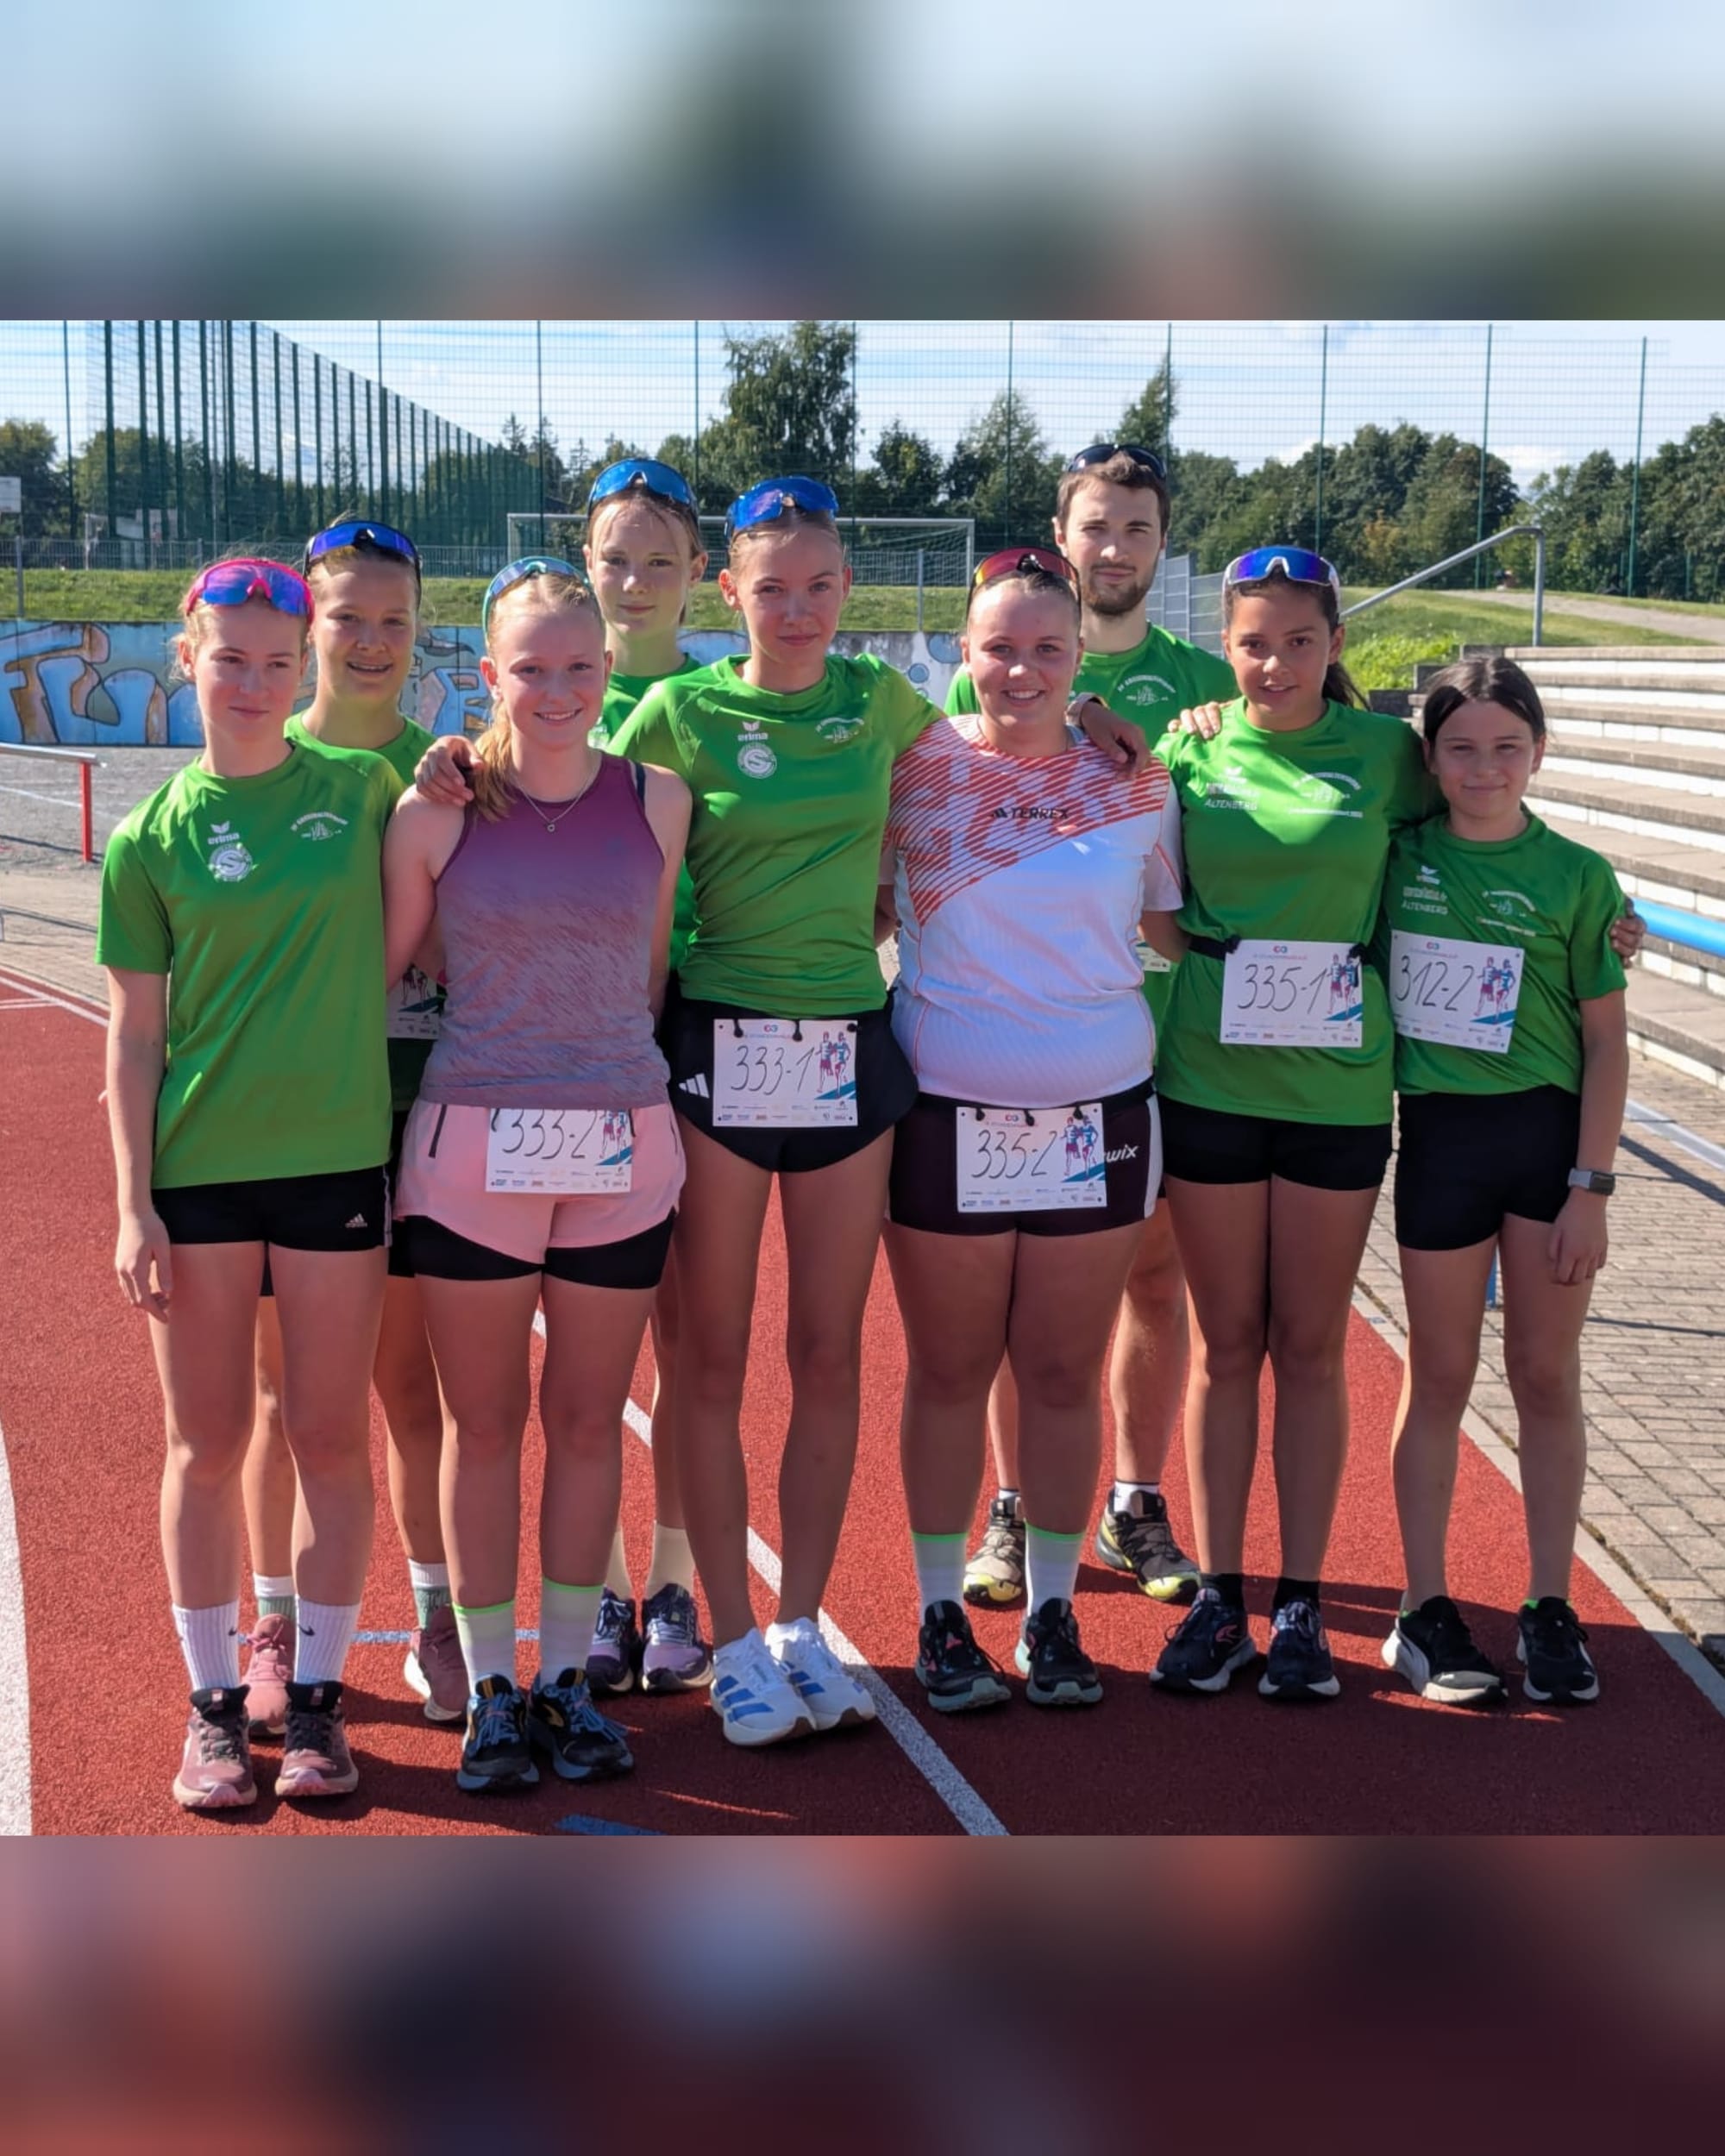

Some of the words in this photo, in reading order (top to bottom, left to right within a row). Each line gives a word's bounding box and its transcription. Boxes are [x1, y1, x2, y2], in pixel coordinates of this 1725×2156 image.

[737, 732, 768, 742] erima
[1010, 807, 1069, 819] TERREX
[207, 832, 240, 845] erima
[1402, 900, 1449, 915] ALTENBERG
[1237, 963, 1327, 1015] 335-1
[1395, 955, 1475, 1012] 312-2
[731, 1044, 815, 1095] 333-1
[502, 1109, 598, 1160] 333-2
[971, 1129, 1057, 1179] 335-2
[1104, 1144, 1138, 1163] wix
